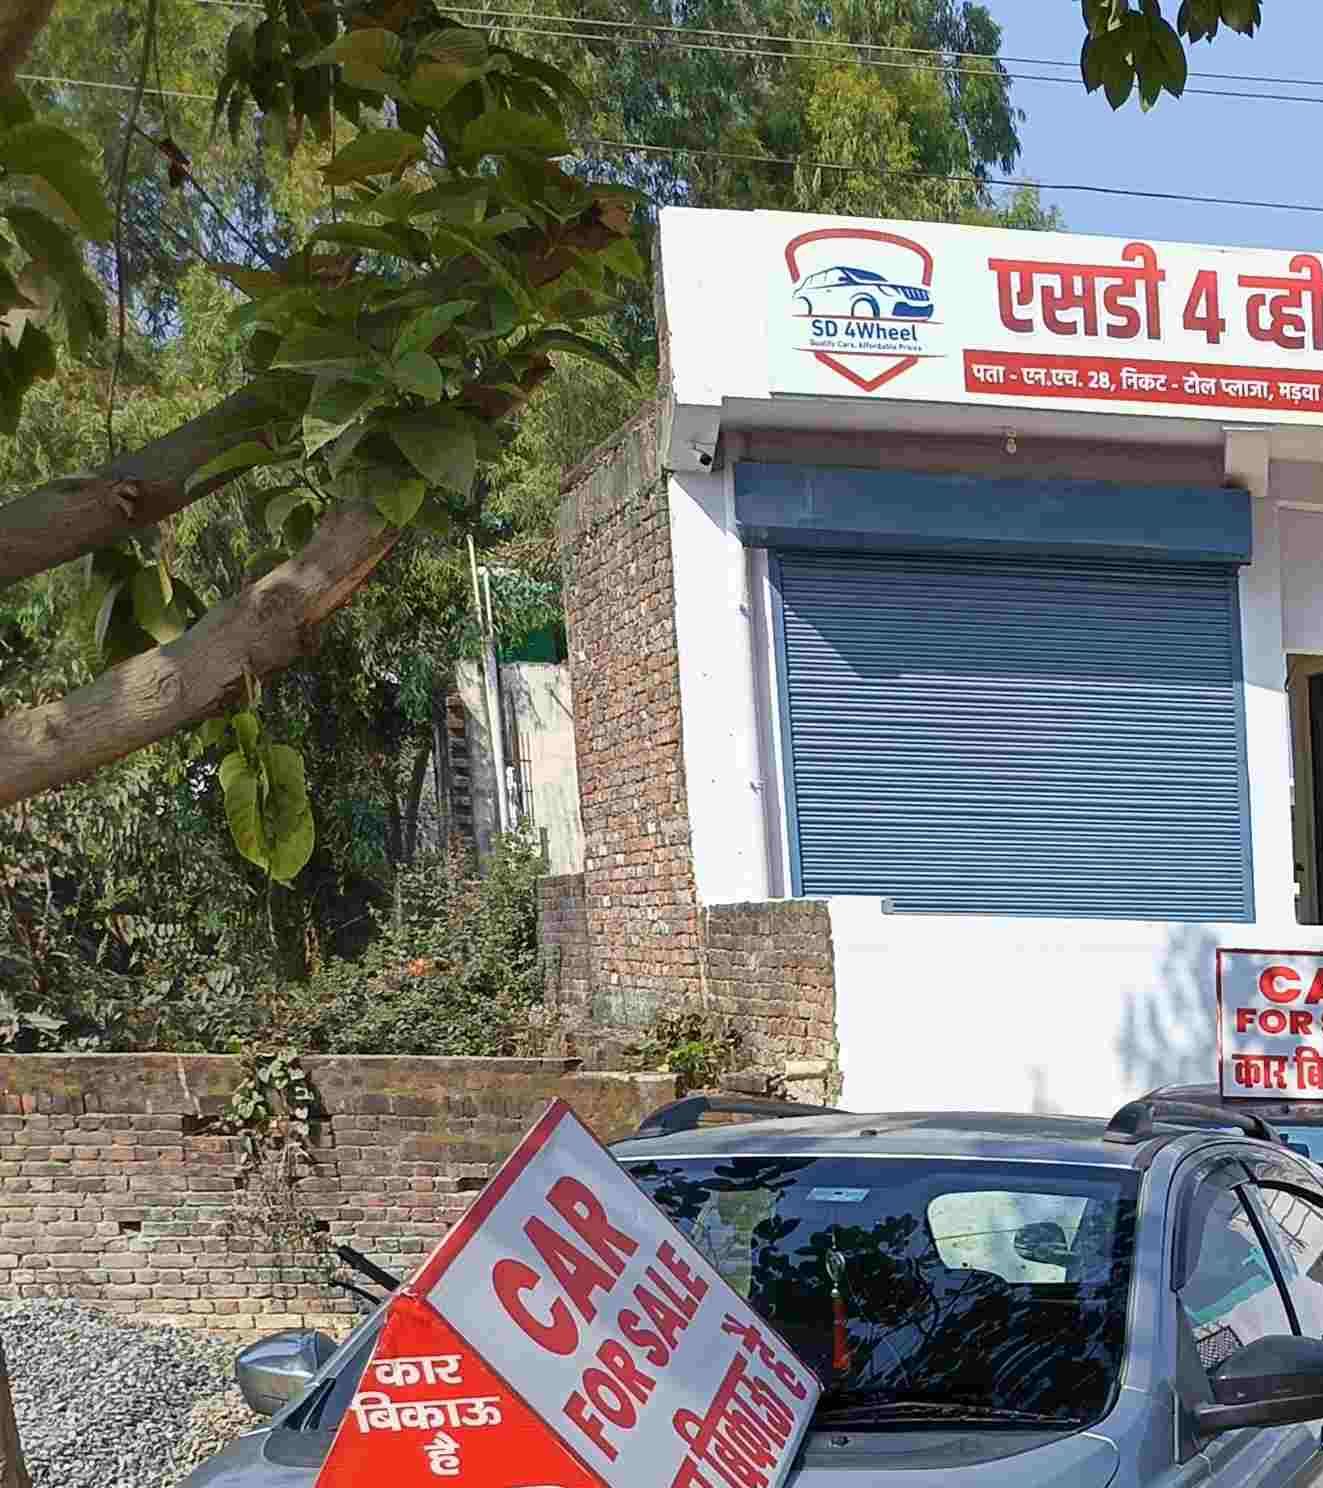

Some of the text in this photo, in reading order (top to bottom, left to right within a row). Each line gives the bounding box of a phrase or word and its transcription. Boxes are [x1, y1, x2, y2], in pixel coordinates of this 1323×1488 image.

[988, 242, 1166, 340] एसडी
[1183, 269, 1226, 344] 4
[811, 319, 918, 342] SD 4Wheel
[972, 363, 1006, 384] पता
[1087, 370, 1116, 393] 28,
[1120, 367, 1168, 391] निकट
[1183, 371, 1216, 395] टोल
[1219, 379, 1275, 401] प्लाजा,
[1235, 1008, 1313, 1036] FOR
[1231, 1053, 1288, 1089] कार
[491, 1175, 640, 1356] CAR
[371, 1353, 464, 1388] कार
[562, 1240, 711, 1463] FOR SALE
[721, 1312, 808, 1402] है
[350, 1390, 502, 1434] बिकाऊ
[423, 1432, 462, 1478] है
